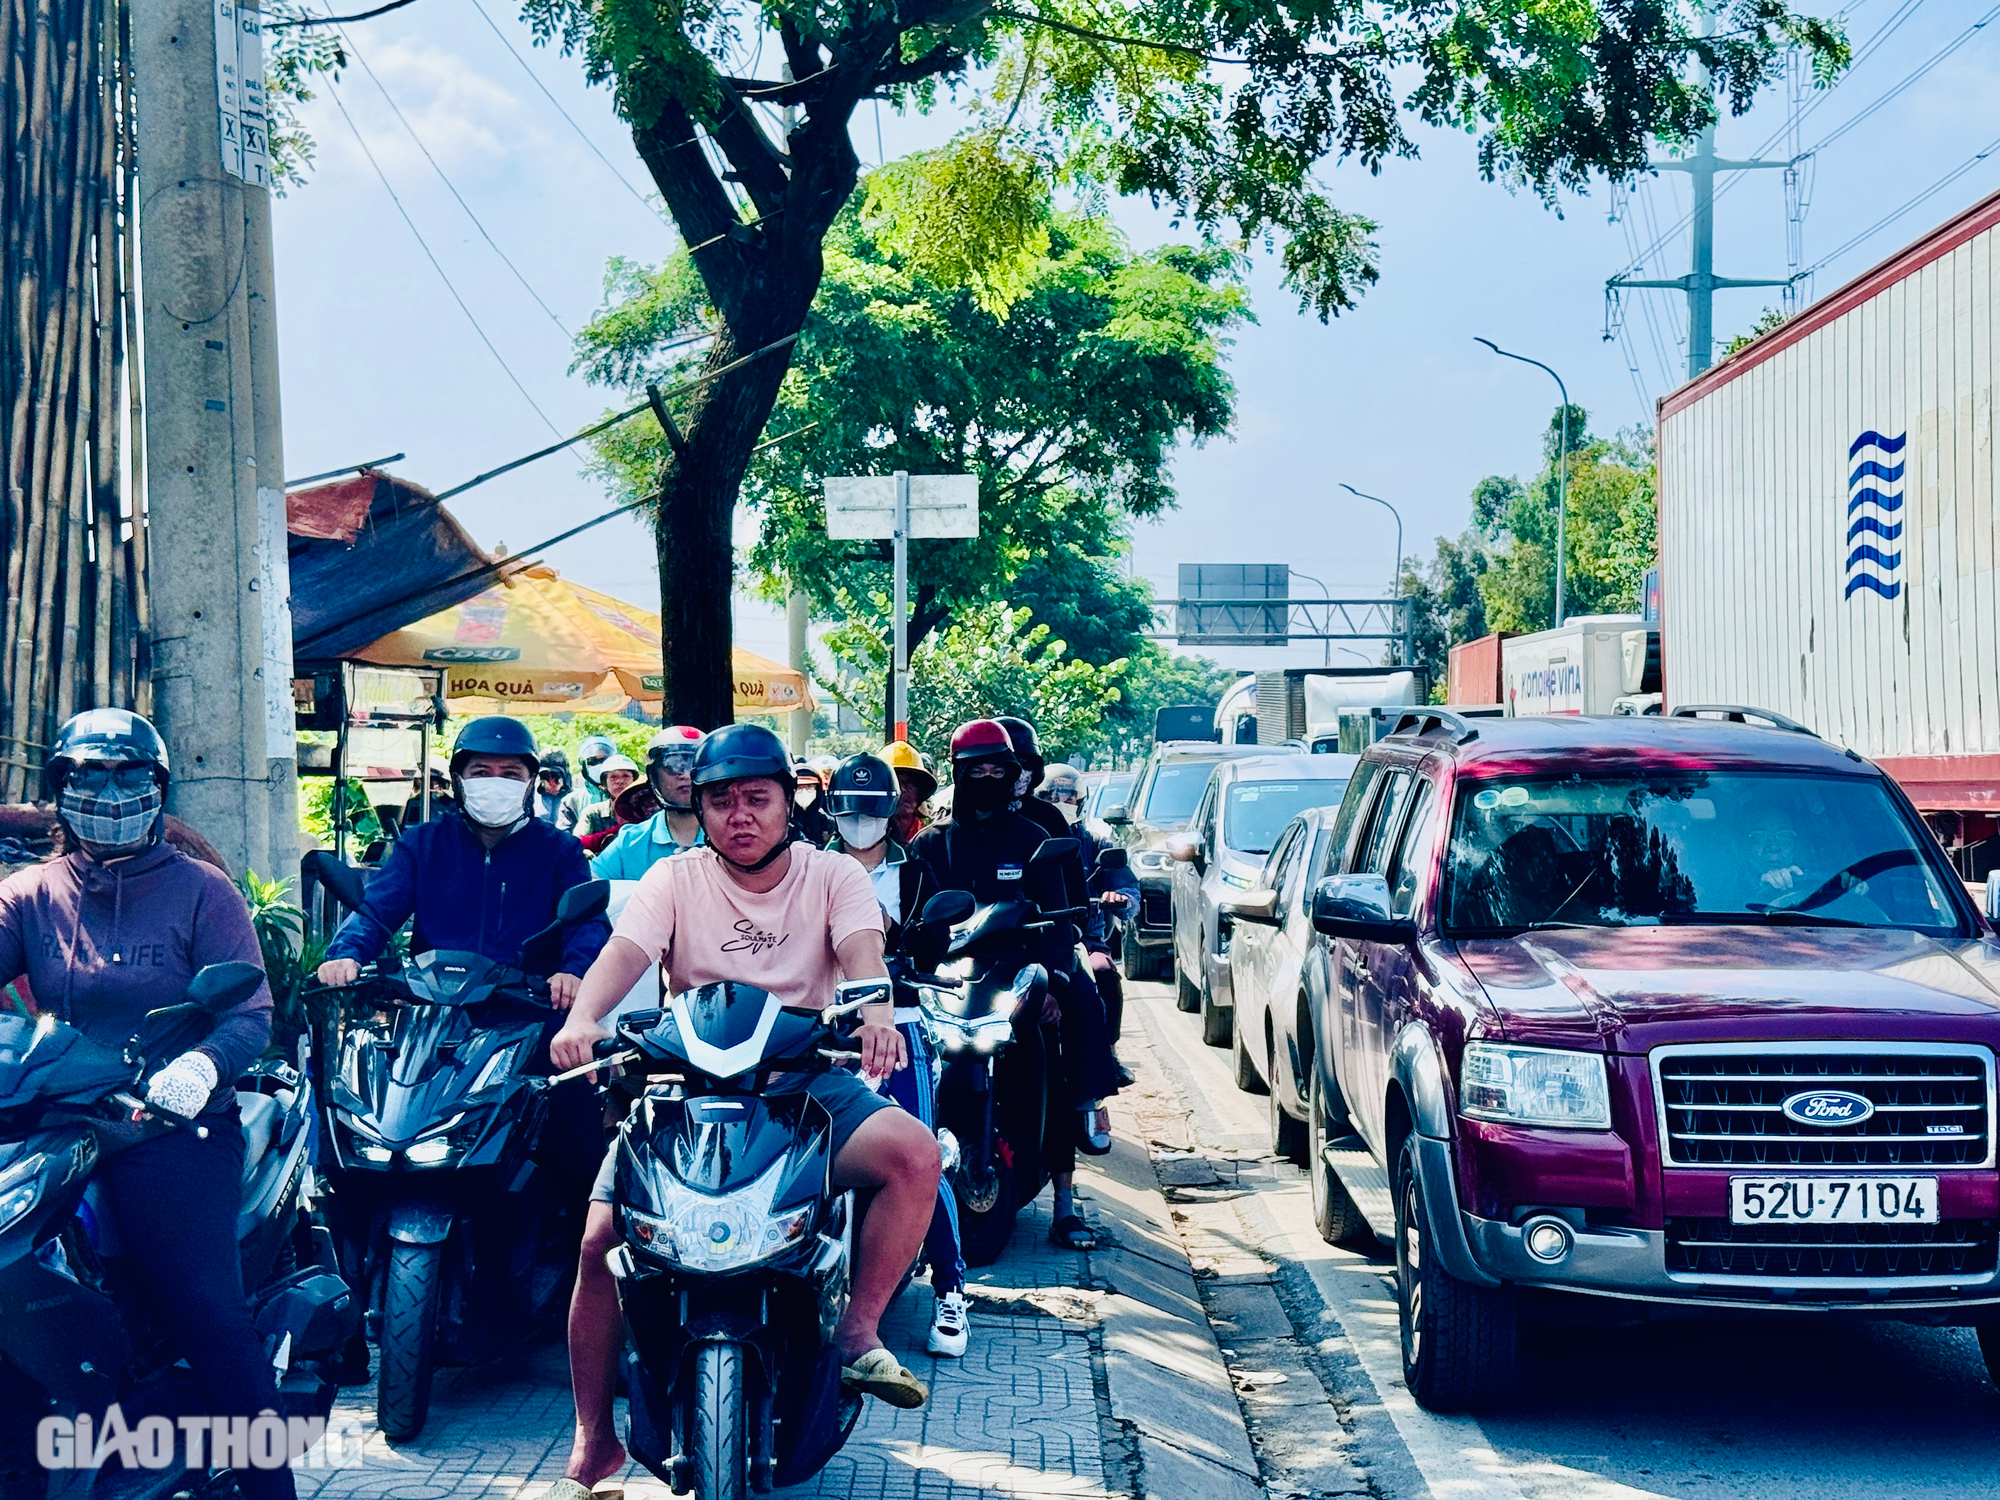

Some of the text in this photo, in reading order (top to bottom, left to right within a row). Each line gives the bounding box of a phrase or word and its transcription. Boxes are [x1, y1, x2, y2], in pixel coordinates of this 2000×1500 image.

[451, 678, 534, 696] HOA QUẢ
[114, 944, 166, 967] LIFE
[1804, 1097, 1852, 1117] Ford
